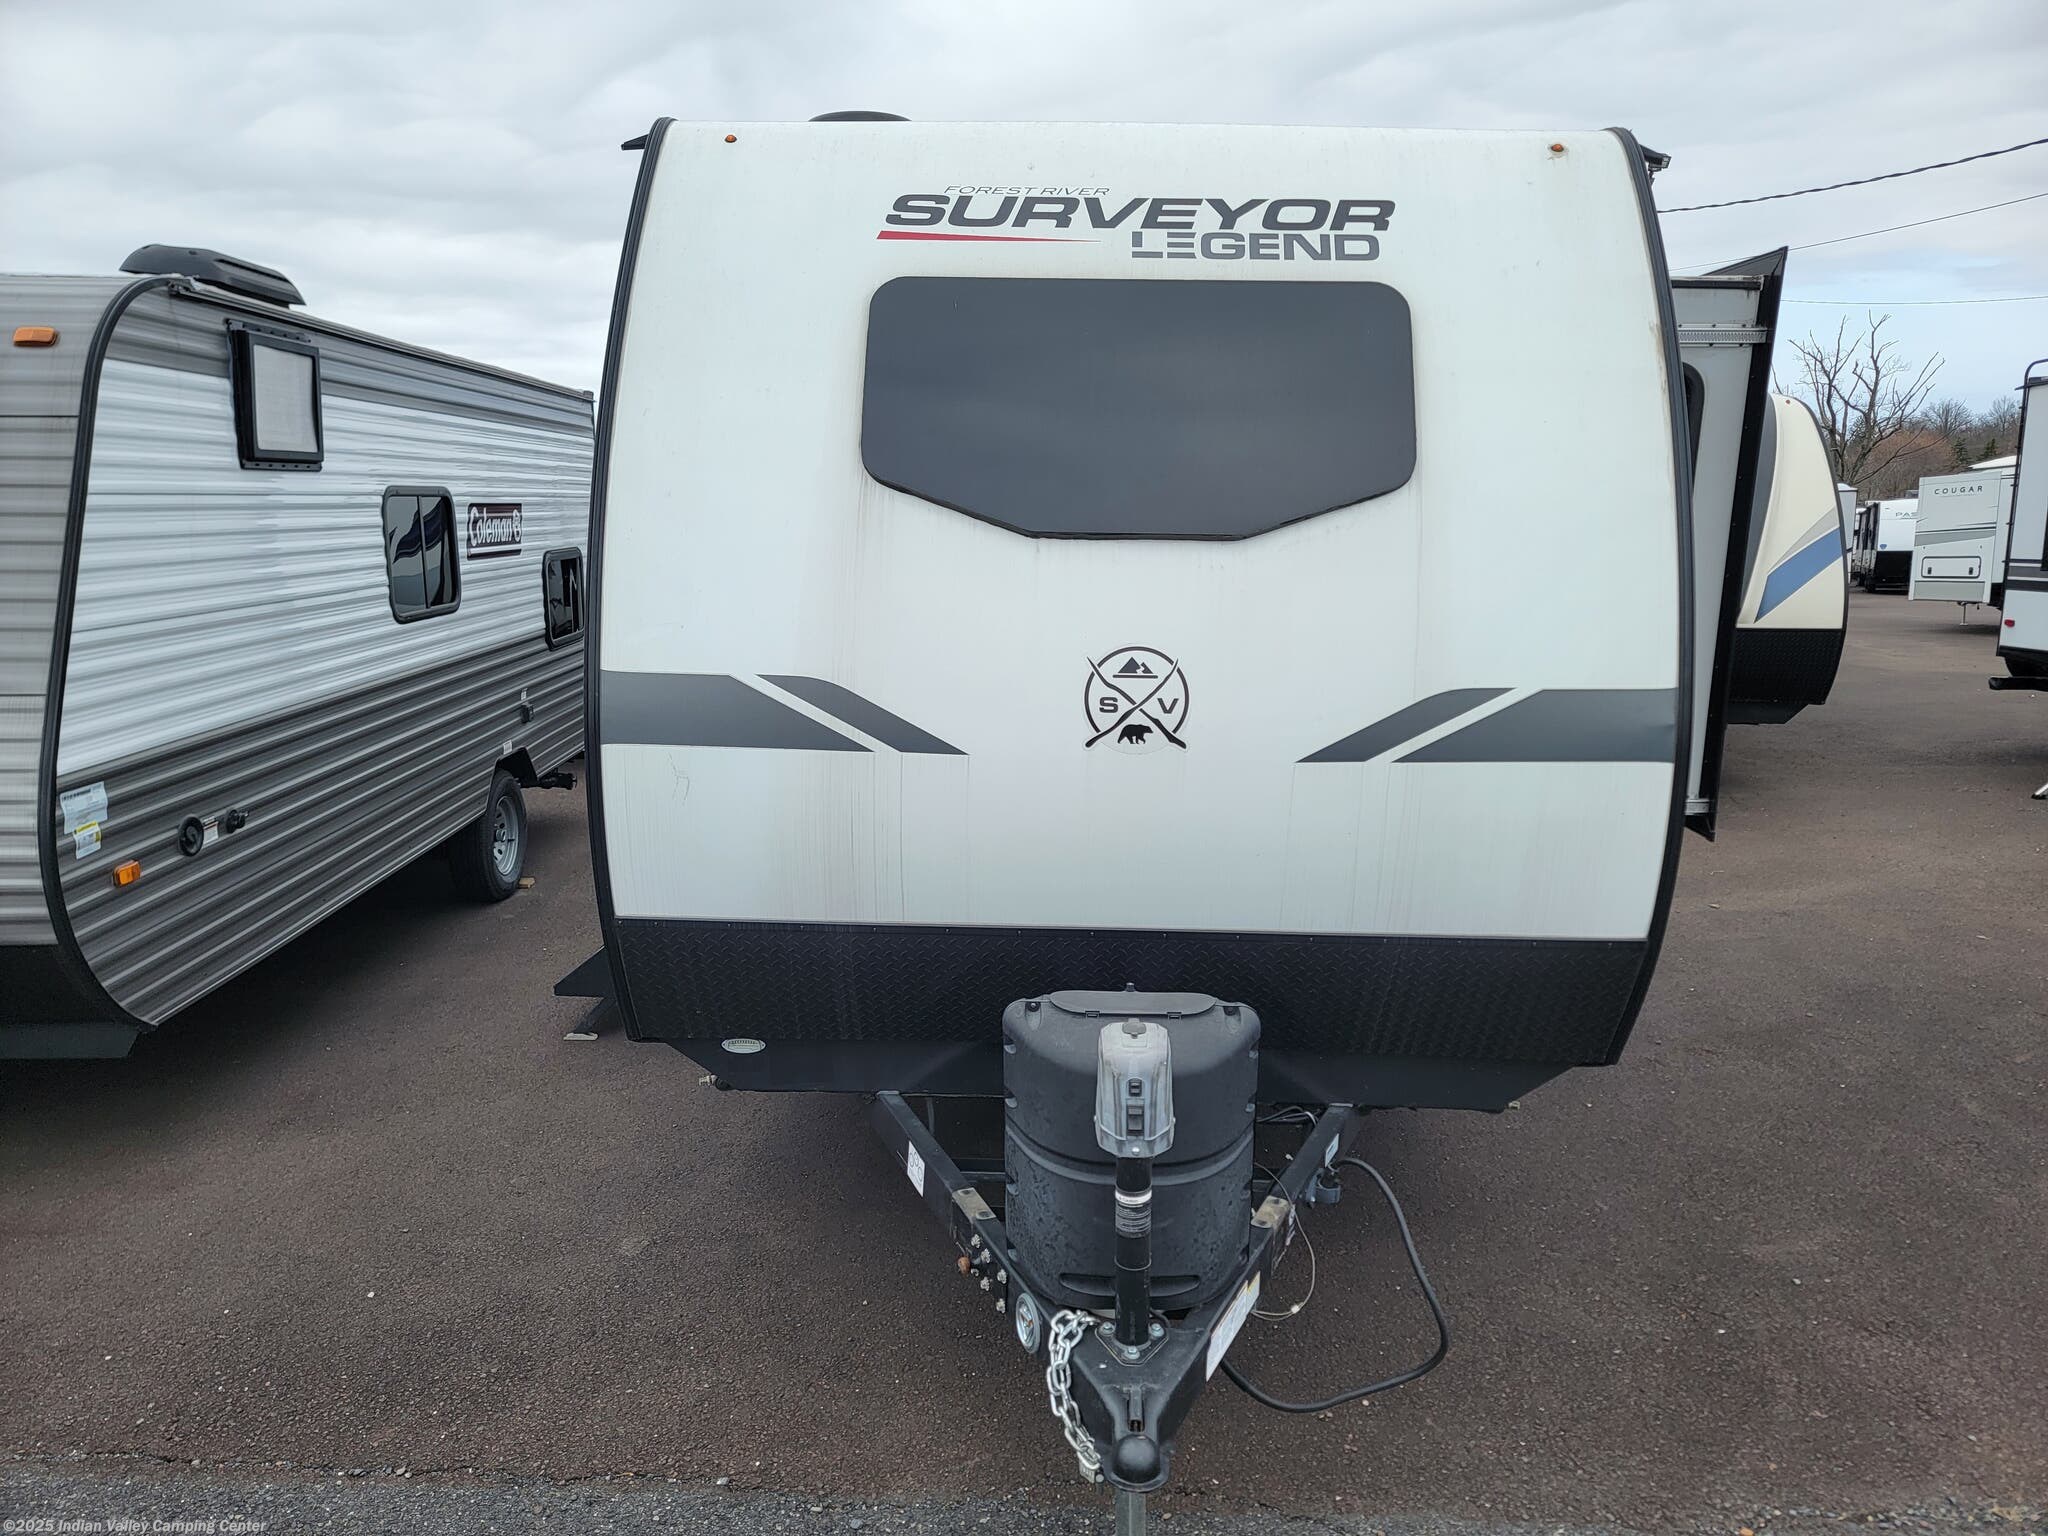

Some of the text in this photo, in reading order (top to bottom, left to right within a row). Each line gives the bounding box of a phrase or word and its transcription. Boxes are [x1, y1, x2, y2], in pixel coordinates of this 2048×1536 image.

[943, 185, 1111, 197] FOREST RIVER
[885, 193, 1396, 231] SURVEYOR
[1131, 231, 1380, 261] LEGEND
[1934, 485, 1983, 495] COUGAR
[468, 506, 513, 547] Coleman
[1098, 696, 1180, 715] S V
